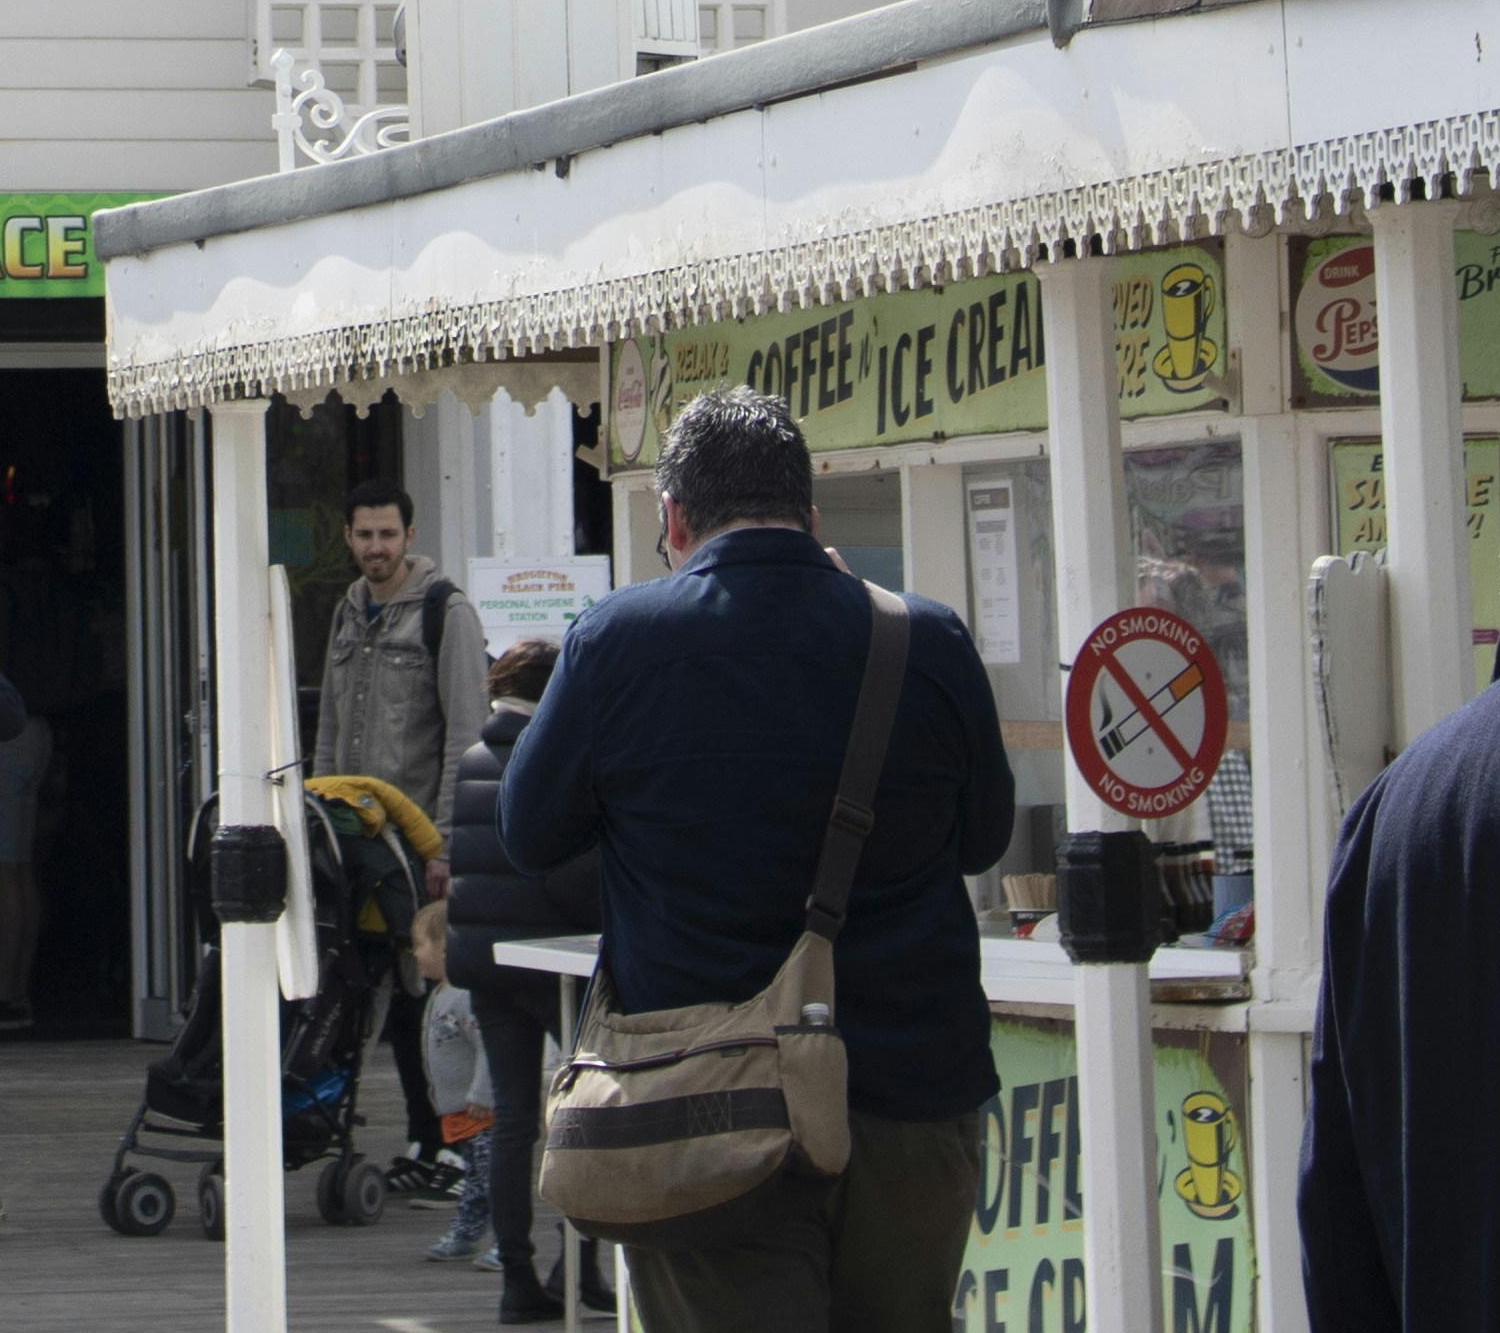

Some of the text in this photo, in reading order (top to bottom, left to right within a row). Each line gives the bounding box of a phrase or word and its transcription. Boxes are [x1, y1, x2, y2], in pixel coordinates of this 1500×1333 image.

[1324, 265, 1360, 280] DRINK
[675, 338, 729, 383] RELAX &
[877, 325, 936, 436] ICE
[945, 280, 1045, 405] CREA
[1115, 333, 1150, 399] RE
[479, 598, 575, 610] PERSONAL HYGIENE
[508, 612, 548, 622] STATION
[1090, 616, 1201, 656] NO SMOKING
[1098, 766, 1205, 813] NO SMOKING
